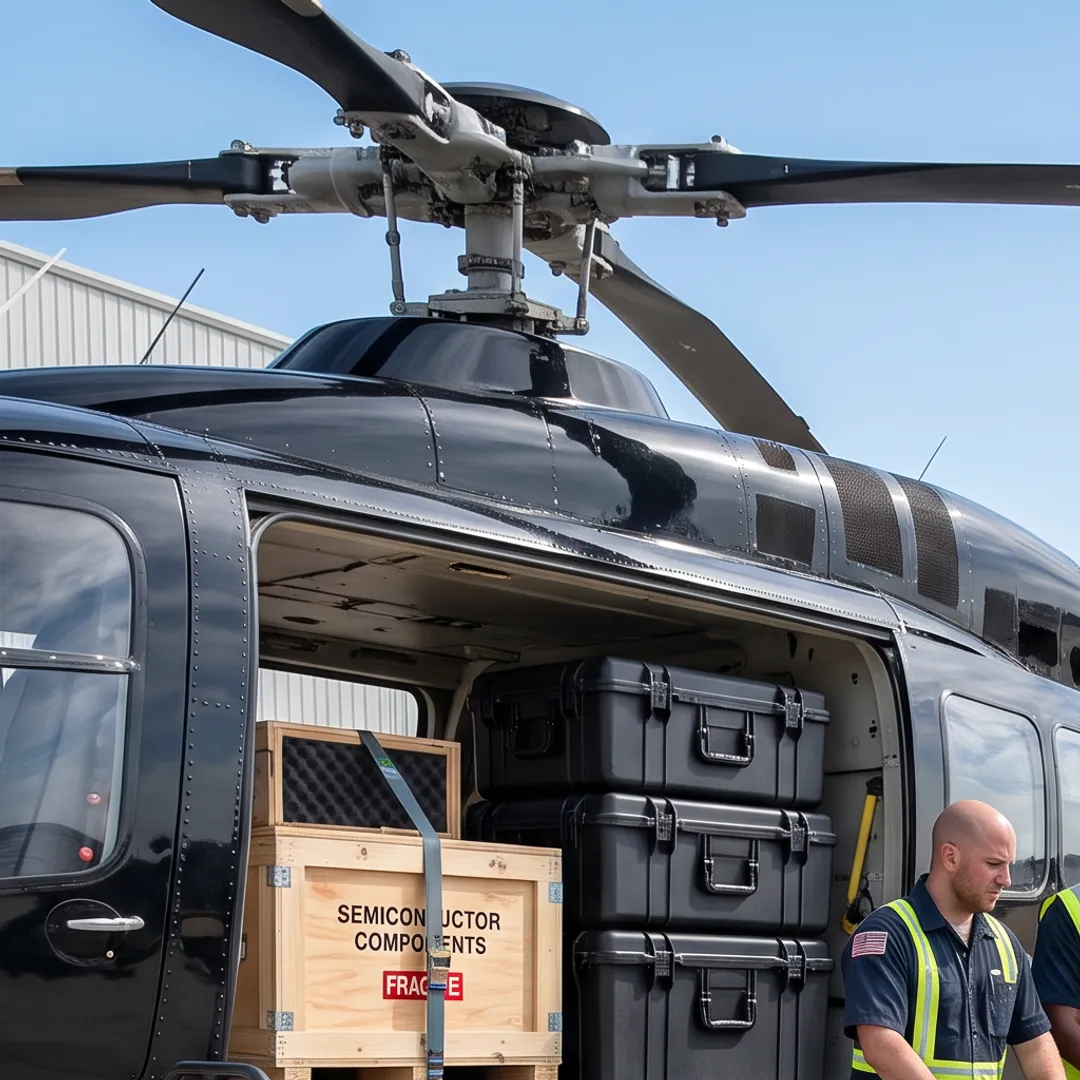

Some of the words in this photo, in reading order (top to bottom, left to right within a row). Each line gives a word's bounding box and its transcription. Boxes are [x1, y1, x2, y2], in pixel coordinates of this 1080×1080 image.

[337, 904, 500, 930] SEMICONUCTOR
[354, 931, 486, 954] COMPOENTS
[386, 974, 460, 996] FRAGE
